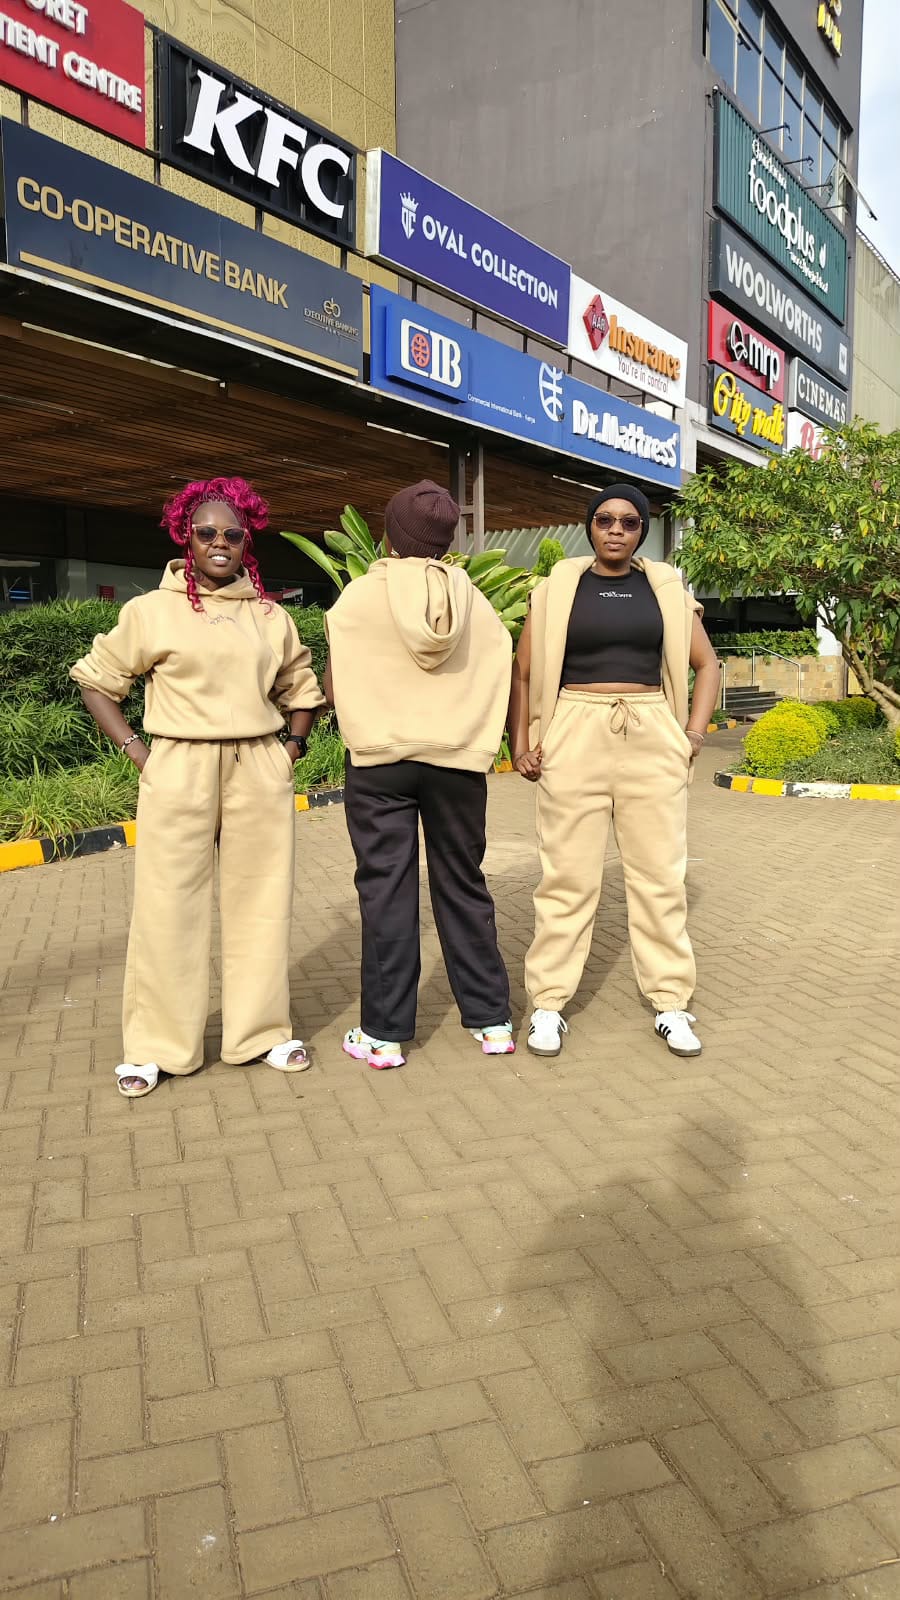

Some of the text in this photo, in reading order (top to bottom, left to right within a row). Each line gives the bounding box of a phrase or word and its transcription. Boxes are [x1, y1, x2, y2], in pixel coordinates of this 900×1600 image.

[63, 51, 142, 113] CENTRE
[183, 69, 350, 218] KFC
[17, 176, 289, 309] CO-OPERATIVE BANK
[748, 158, 815, 264] foodplus
[422, 215, 558, 310] OVAL COLLECTION
[726, 244, 822, 353] WOOLWORTHS
[400, 318, 462, 389] CIB
[609, 314, 681, 382] Insurance
[617, 356, 669, 394] You're in control
[748, 333, 780, 391] mrp
[713, 372, 752, 435] City
[797, 373, 846, 424] CINEMAS
